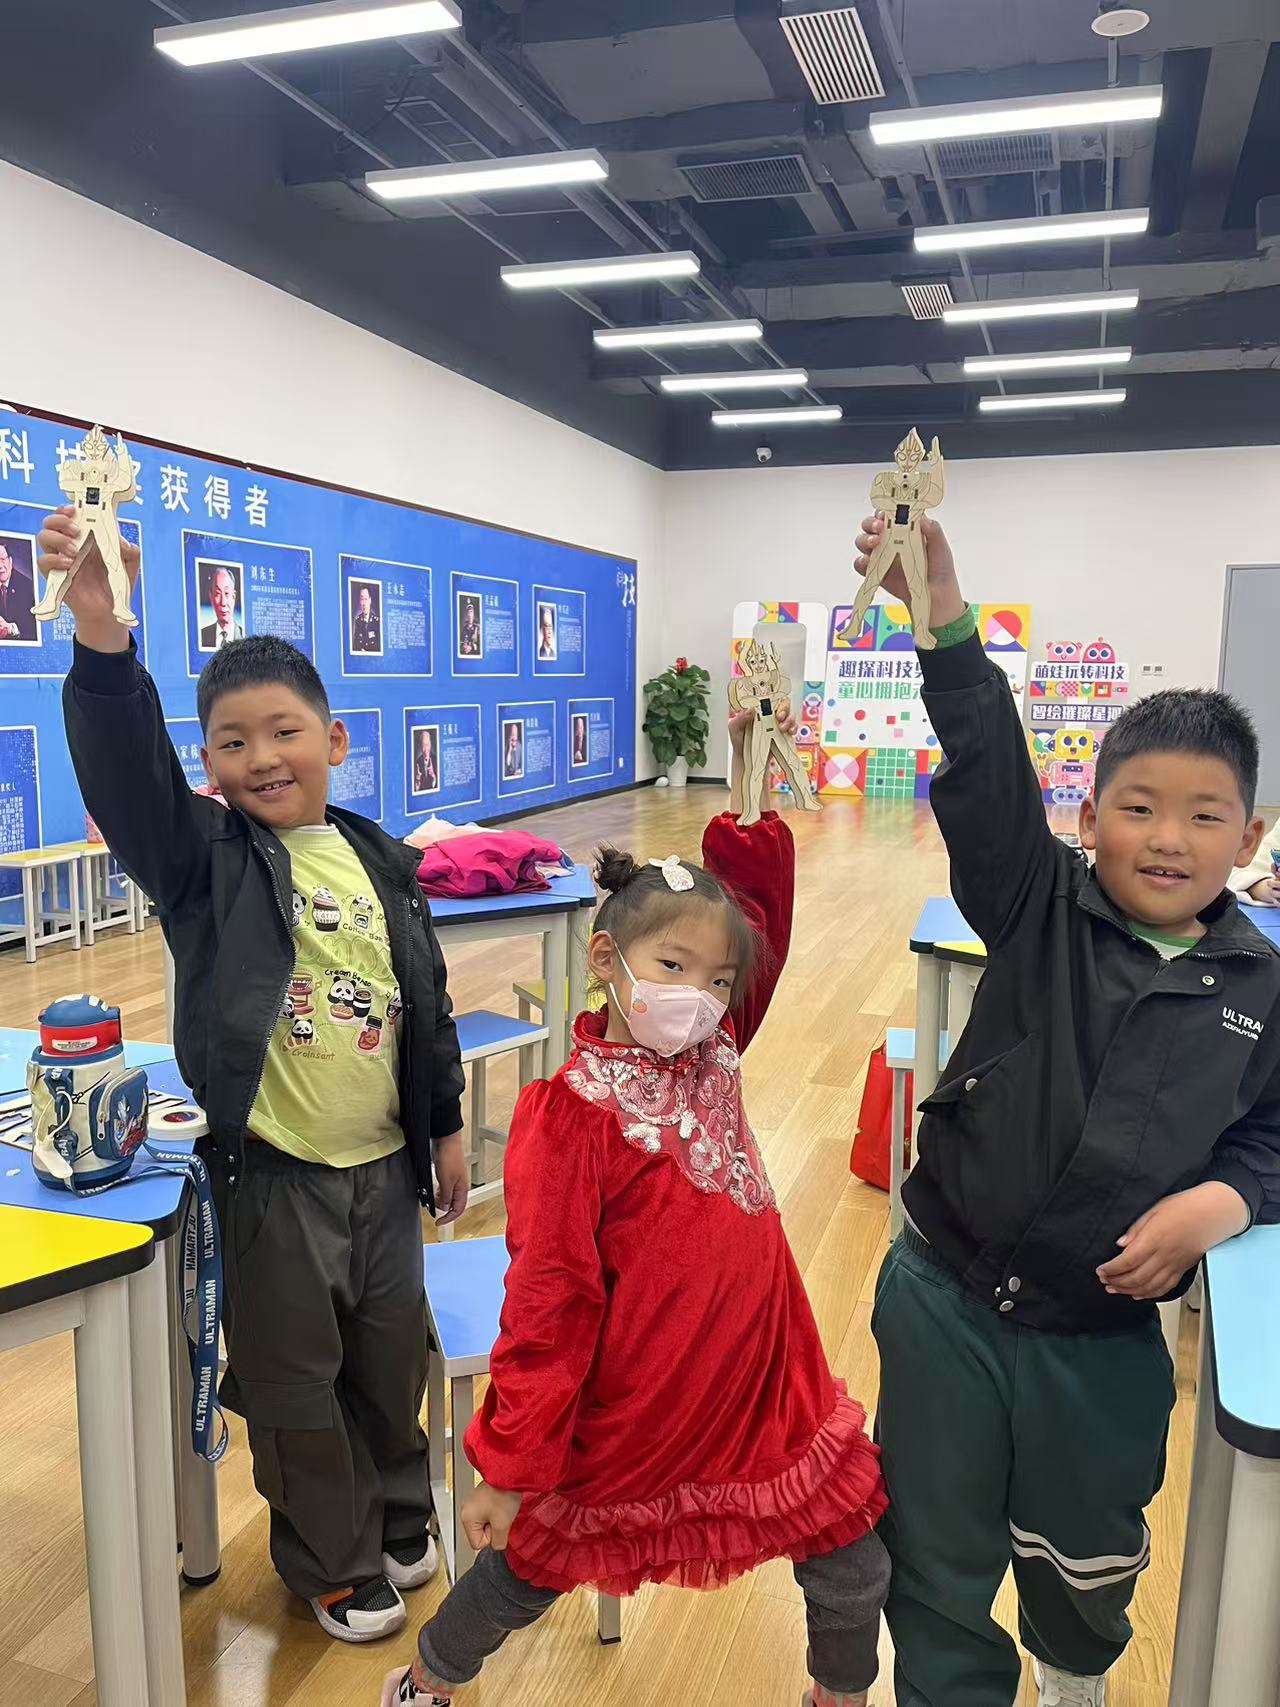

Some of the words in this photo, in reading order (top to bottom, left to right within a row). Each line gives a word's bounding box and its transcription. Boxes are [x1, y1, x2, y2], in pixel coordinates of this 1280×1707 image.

[0, 428, 269, 528] 科获得者
[1035, 664, 1126, 680] 萌娃玩转科技
[1222, 1006, 1264, 1033] ULTRA
[201, 1200, 215, 1259] ULTRAMAN
[204, 1279, 217, 1345] ULTRAMAN
[195, 1366, 212, 1432] ULTRAMAN
